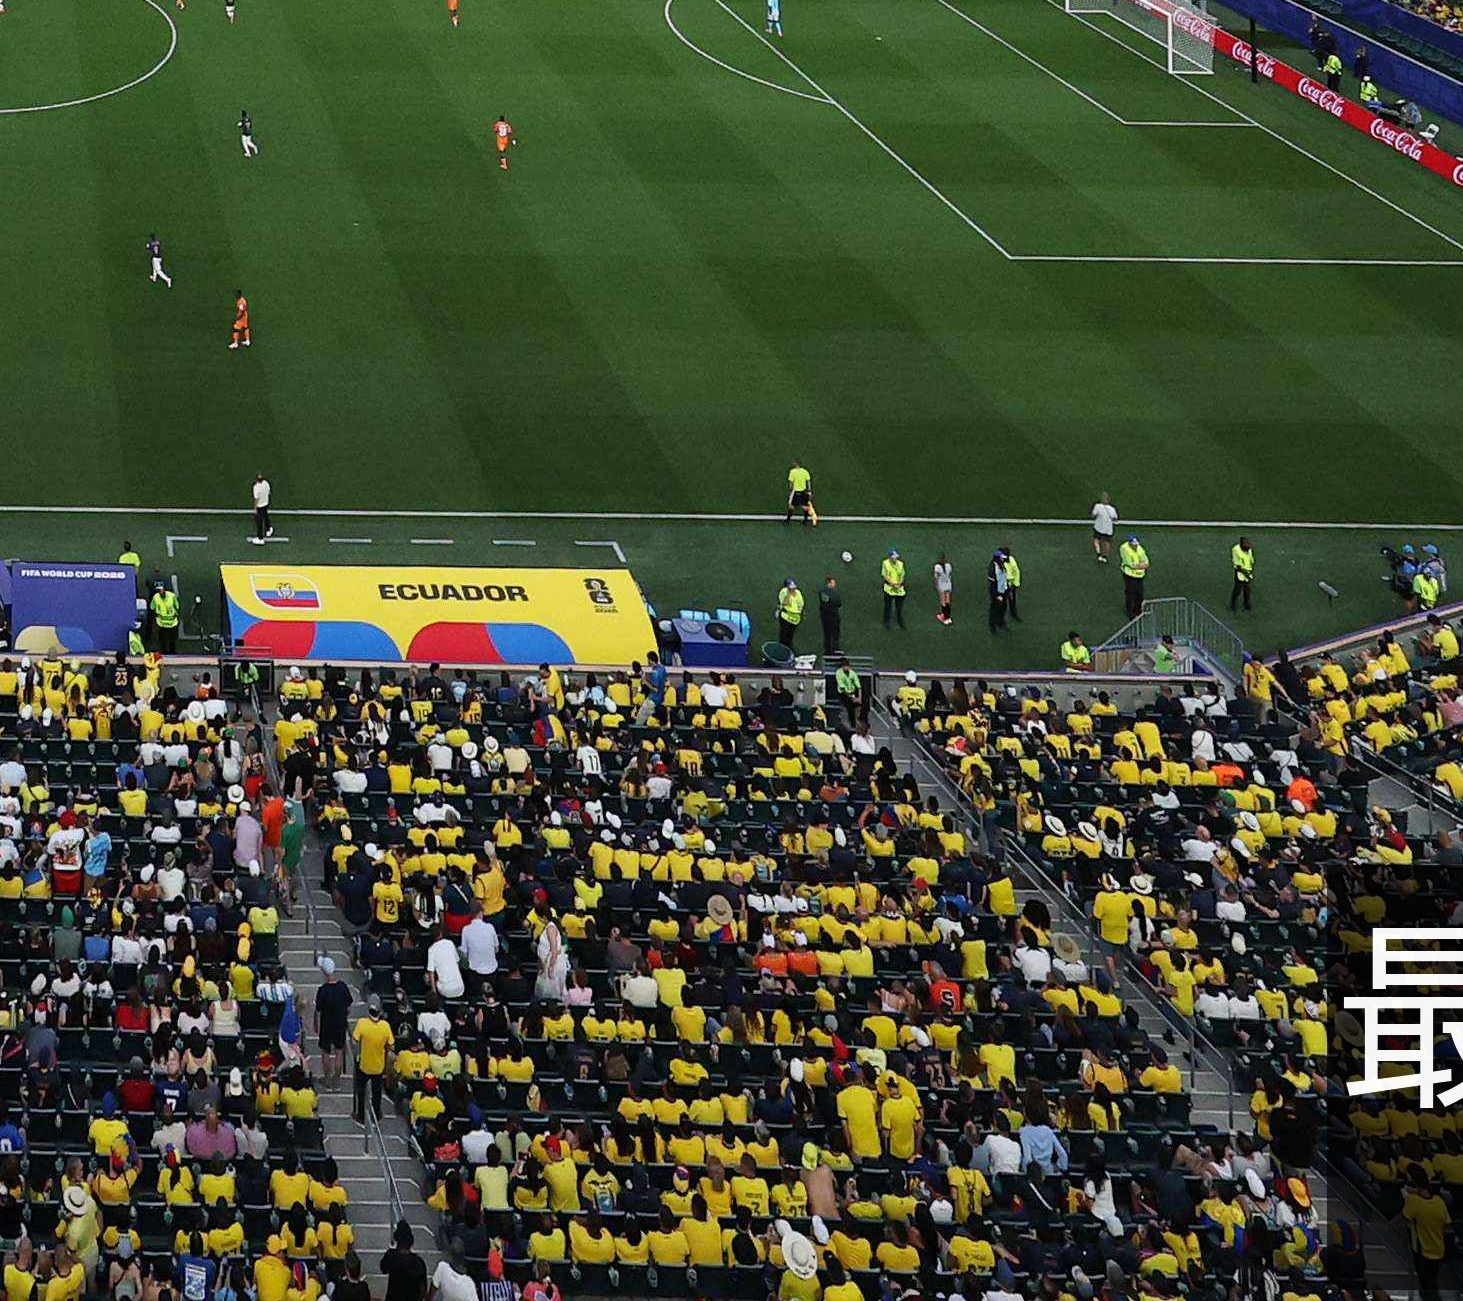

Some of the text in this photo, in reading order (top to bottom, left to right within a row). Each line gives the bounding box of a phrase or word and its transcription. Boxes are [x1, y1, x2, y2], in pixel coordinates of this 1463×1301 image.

[21, 569, 41, 578] FIFA
[42, 570, 74, 579] WORLD
[76, 570, 93, 579] CUP
[378, 583, 529, 602] ECUADOR
